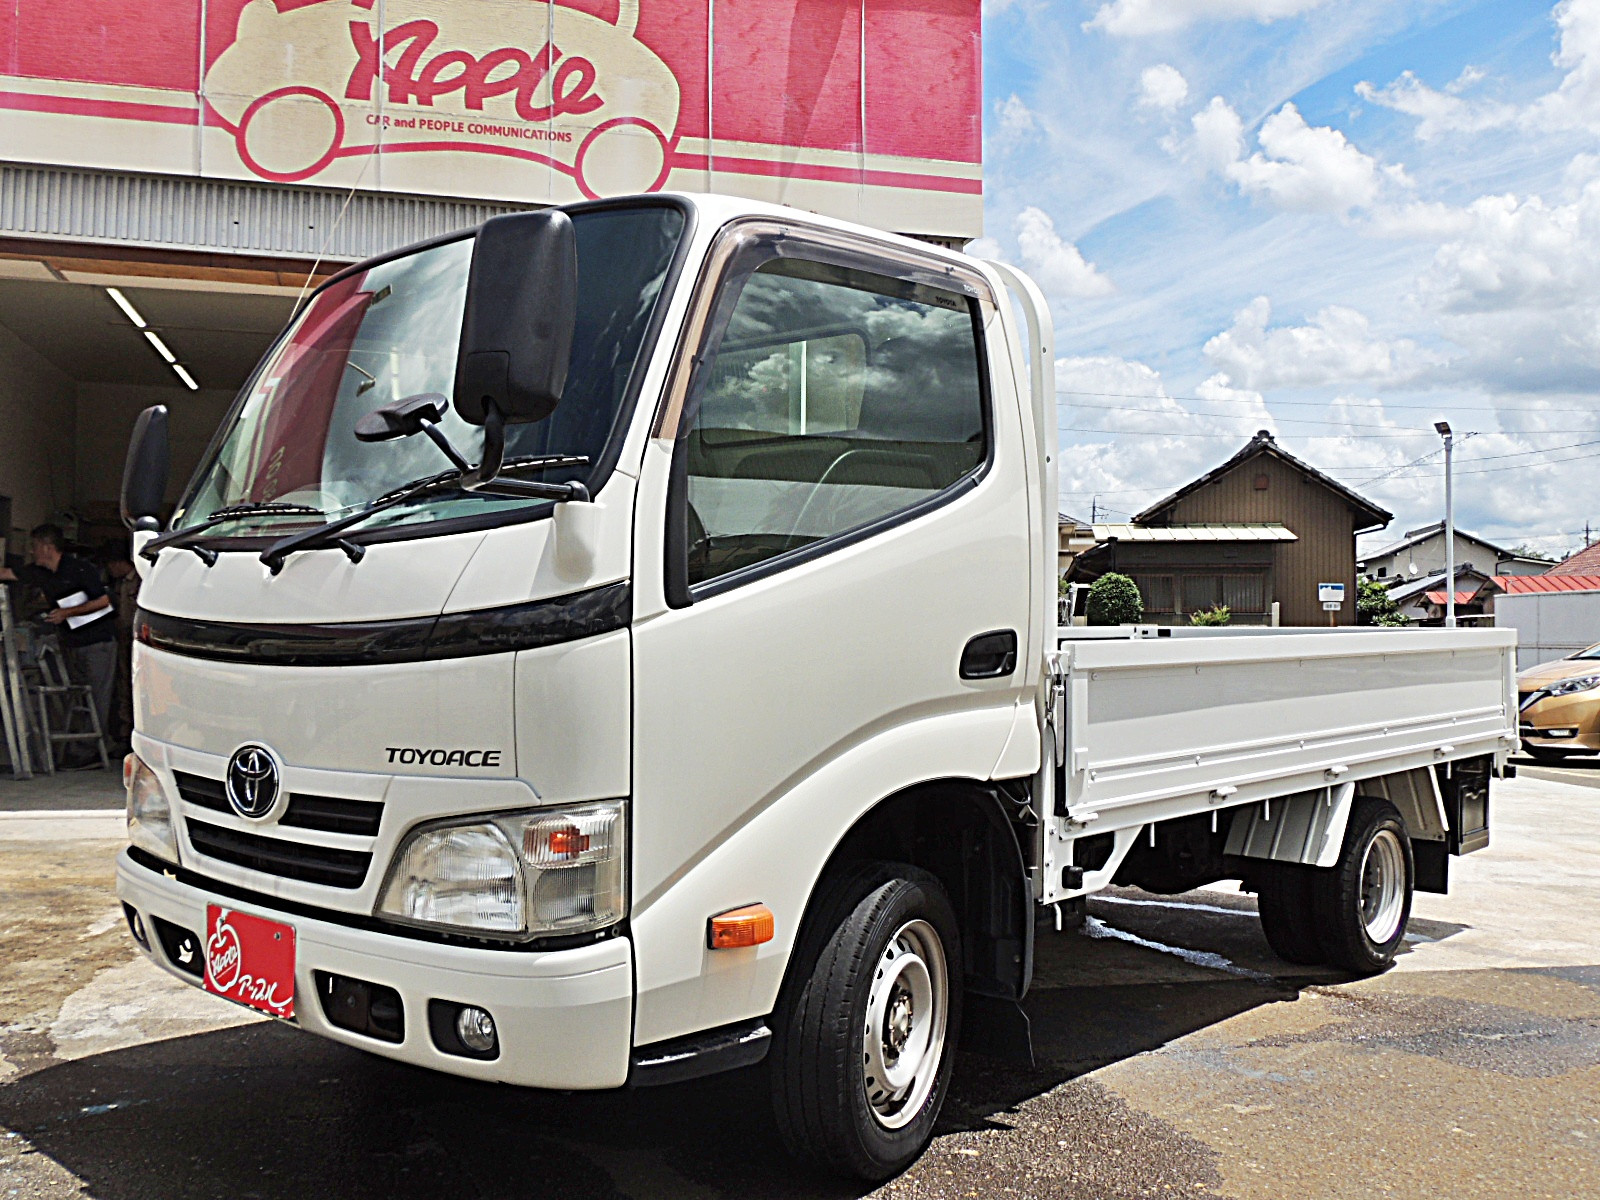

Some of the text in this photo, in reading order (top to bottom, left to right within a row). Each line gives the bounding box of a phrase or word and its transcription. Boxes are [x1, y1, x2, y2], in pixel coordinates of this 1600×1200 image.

[344, 18, 605, 122] Apple
[366, 113, 572, 143] CAR and PEOPLE COMMUNICATIONS
[385, 747, 502, 767] TOYOACE
